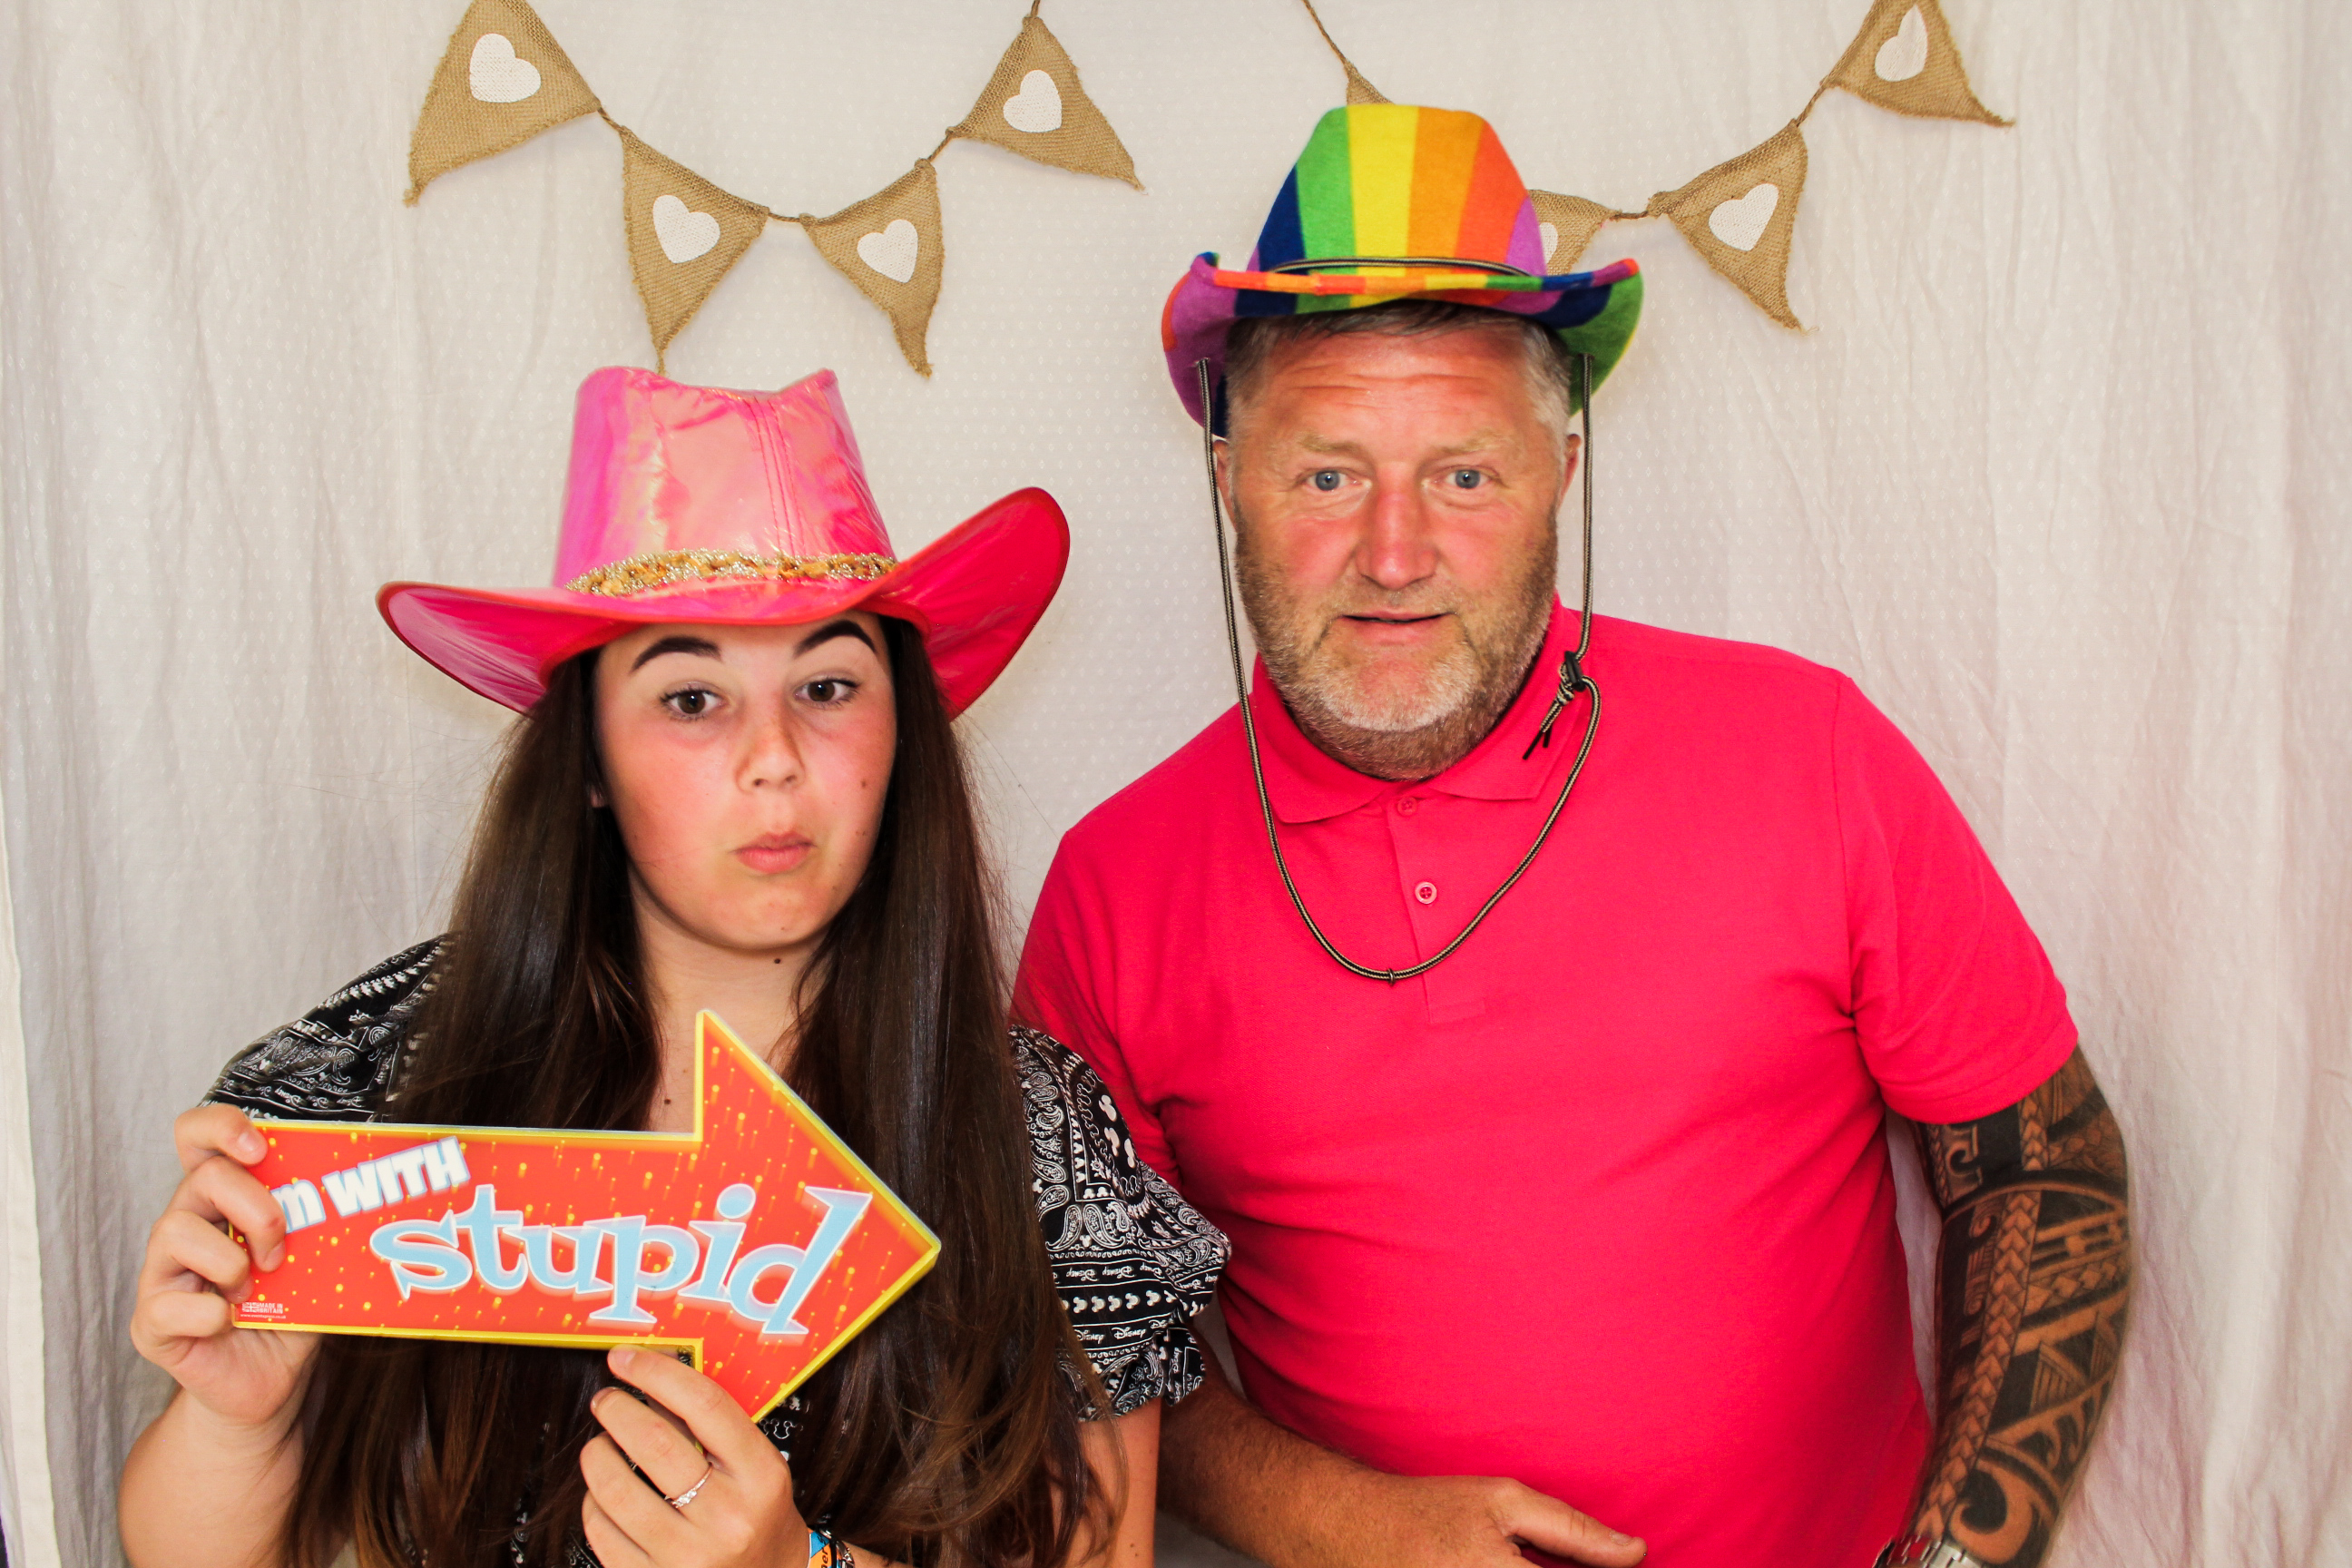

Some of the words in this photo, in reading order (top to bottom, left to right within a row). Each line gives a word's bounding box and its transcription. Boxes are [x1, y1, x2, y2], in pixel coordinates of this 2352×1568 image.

[321, 1135, 471, 1217] WITH
[369, 1183, 873, 1335] stupid
[1066, 1266, 1099, 1281] Disney
[1102, 1265, 1136, 1279] Disney
[1111, 1326, 1147, 1339] Disney
